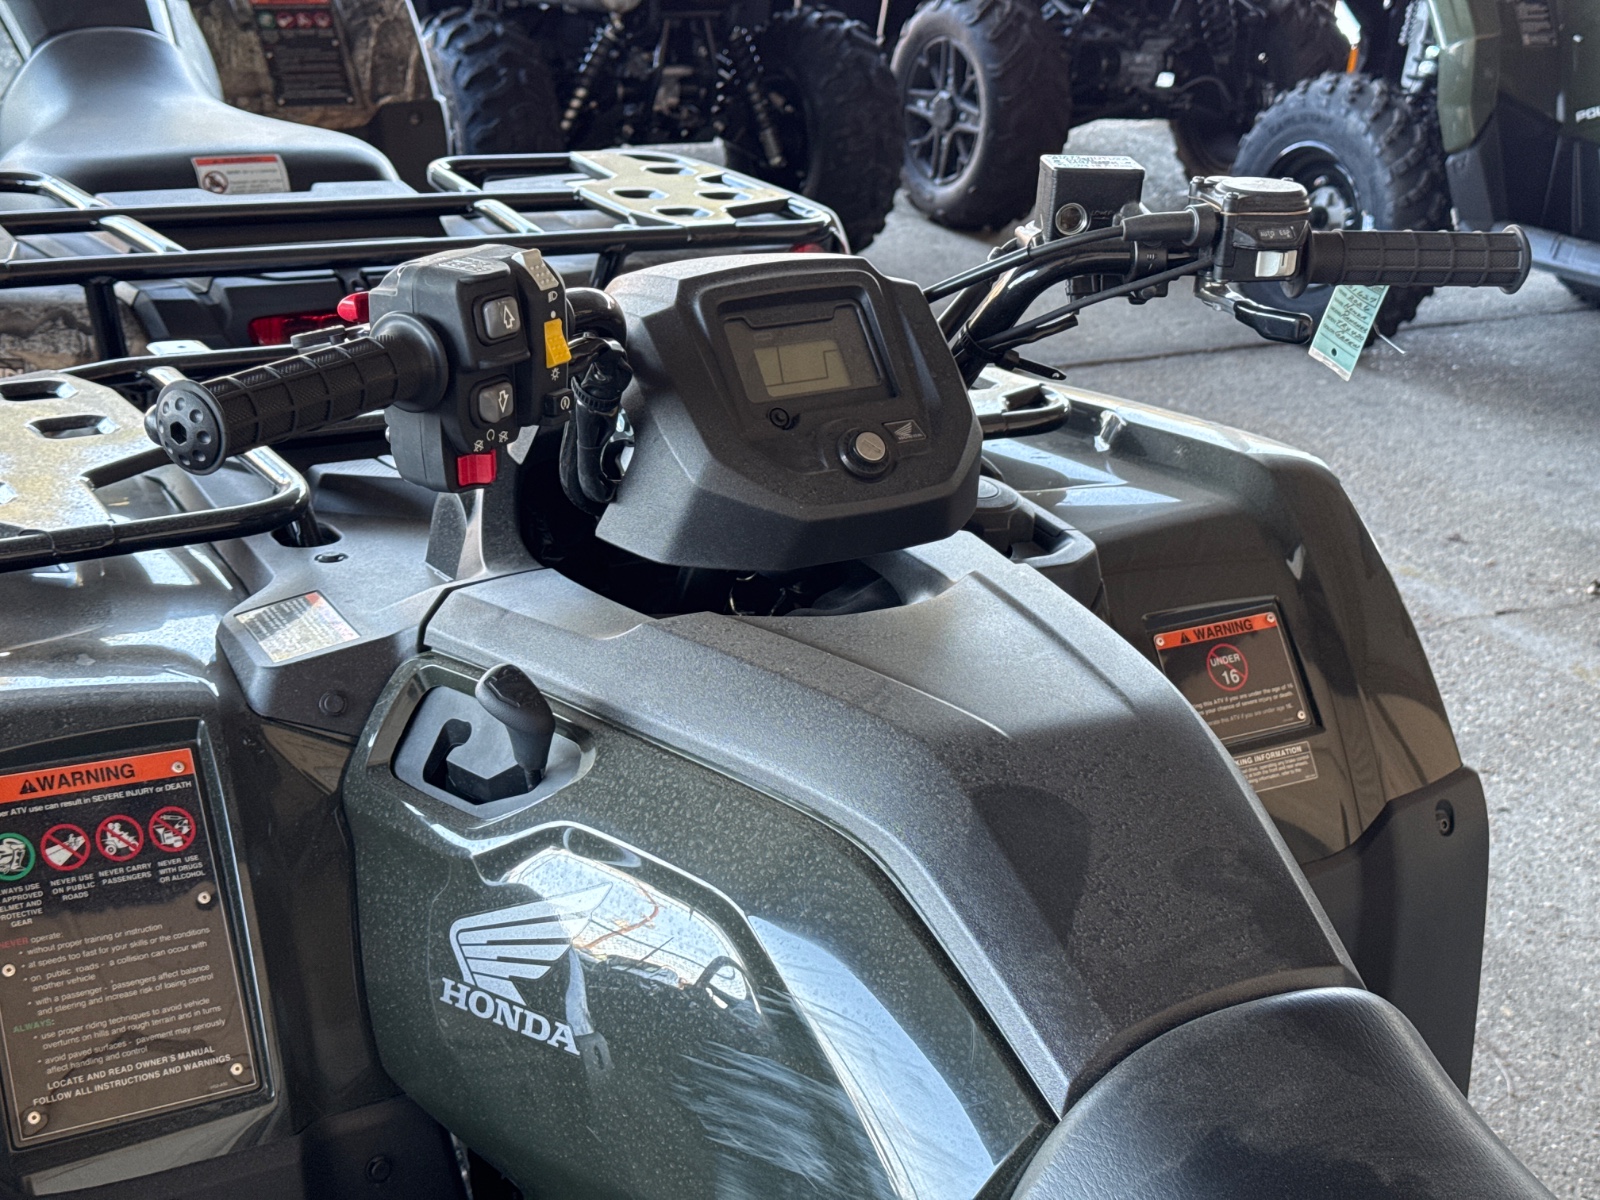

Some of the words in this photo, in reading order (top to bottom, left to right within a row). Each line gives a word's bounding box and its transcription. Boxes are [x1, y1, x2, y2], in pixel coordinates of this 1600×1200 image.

[1193, 619, 1254, 641] WARNING
[1210, 653, 1240, 667] UNDER
[1222, 668, 1240, 685] 16
[1254, 746, 1302, 762] INFORMATION
[36, 763, 136, 792] WARNING
[10, 806, 27, 816] ATV
[28, 804, 44, 813] use
[60, 799, 82, 808] result
[92, 790, 124, 802] SEVERE
[126, 786, 154, 797] INJURY
[164, 780, 192, 792] DEATH
[157, 857, 182, 867] NEVER
[184, 854, 199, 862] USE
[159, 866, 176, 875] WITH
[178, 862, 203, 872] DRUGS
[98, 867, 124, 878] NEVER
[126, 862, 152, 872] CARRY
[102, 870, 152, 886] PASSENGERS
[172, 870, 206, 882] ALCOHOL
[25, 882, 40, 890] USE
[50, 876, 76, 887] NEVER
[78, 873, 94, 882] USE
[66, 881, 96, 892] PUBLIC
[2, 890, 44, 904] APPROVED
[26, 900, 42, 908] AND
[62, 890, 89, 901] ROADS
[0, 908, 43, 920] ROTECTIVE
[10, 918, 33, 928] GEAR
[26, 944, 56, 956] without
[57, 938, 82, 952] proper
[84, 932, 114, 944] training
[124, 924, 162, 936] instruction
[28, 960, 36, 969] at
[38, 954, 66, 967] speeds
[68, 952, 81, 960] too
[82, 948, 98, 958] fast
[98, 946, 110, 954] for
[111, 943, 128, 954] your
[130, 938, 148, 948] skills
[150, 936, 158, 944] or
[159, 934, 172, 942] the
[172, 927, 210, 940] conditions
[30, 974, 42, 982] on
[46, 968, 72, 980] public
[76, 963, 100, 973] roads
[116, 952, 150, 965] collision
[150, 950, 166, 958] can
[167, 944, 190, 955] occur
[191, 940, 208, 950] with
[32, 980, 65, 993] another
[66, 974, 96, 986] vehicle
[36, 997, 52, 1006] with
[61, 986, 102, 1002] passenger
[112, 974, 156, 992] passengers
[158, 970, 179, 980] affect
[180, 964, 210, 976] balance
[38, 1006, 53, 1017] and
[54, 1000, 87, 1014] steering
[88, 996, 104, 1006] and
[105, 989, 138, 1002] increase
[140, 986, 154, 995] risk
[155, 983, 163, 991] of
[164, 980, 187, 990] losing
[188, 972, 214, 984] control
[41, 1032, 56, 1040] use
[58, 1025, 84, 1038] proper
[86, 1020, 108, 1030] riding
[108, 1010, 151, 1025] techniques
[162, 1004, 182, 1014] avoid
[184, 997, 210, 1009] vehicle
[440, 977, 580, 1056] HONDA
[13, 1018, 56, 1034] ALWAYS:
[42, 1036, 80, 1050] overturns
[82, 1032, 93, 1040] on
[94, 1028, 110, 1038] hills
[111, 1025, 126, 1034] and
[127, 1020, 150, 1032] rough
[152, 1015, 176, 1026] terrain
[178, 1010, 192, 1020] and
[202, 1004, 222, 1014] turns
[44, 1053, 66, 1065] avoid
[68, 1048, 92, 1060] paved
[94, 1040, 128, 1054] surfaces
[136, 1028, 174, 1046] pavement
[174, 1026, 192, 1036] may
[192, 1018, 226, 1032] seriously
[46, 1064, 69, 1075] affect
[70, 1056, 104, 1069] handling
[106, 1051, 120, 1062] and
[122, 1046, 148, 1058] control
[46, 1074, 85, 1091] LOCATE
[87, 1070, 106, 1082] AND
[108, 1064, 134, 1076] READ
[136, 1054, 176, 1070] OWNER'S
[177, 1045, 216, 1062] MANUAL
[32, 1090, 72, 1106] FOLLOW
[74, 1086, 94, 1098] ALL
[94, 1070, 161, 1092] INSTRUCTIONS
[162, 1066, 182, 1076] AND
